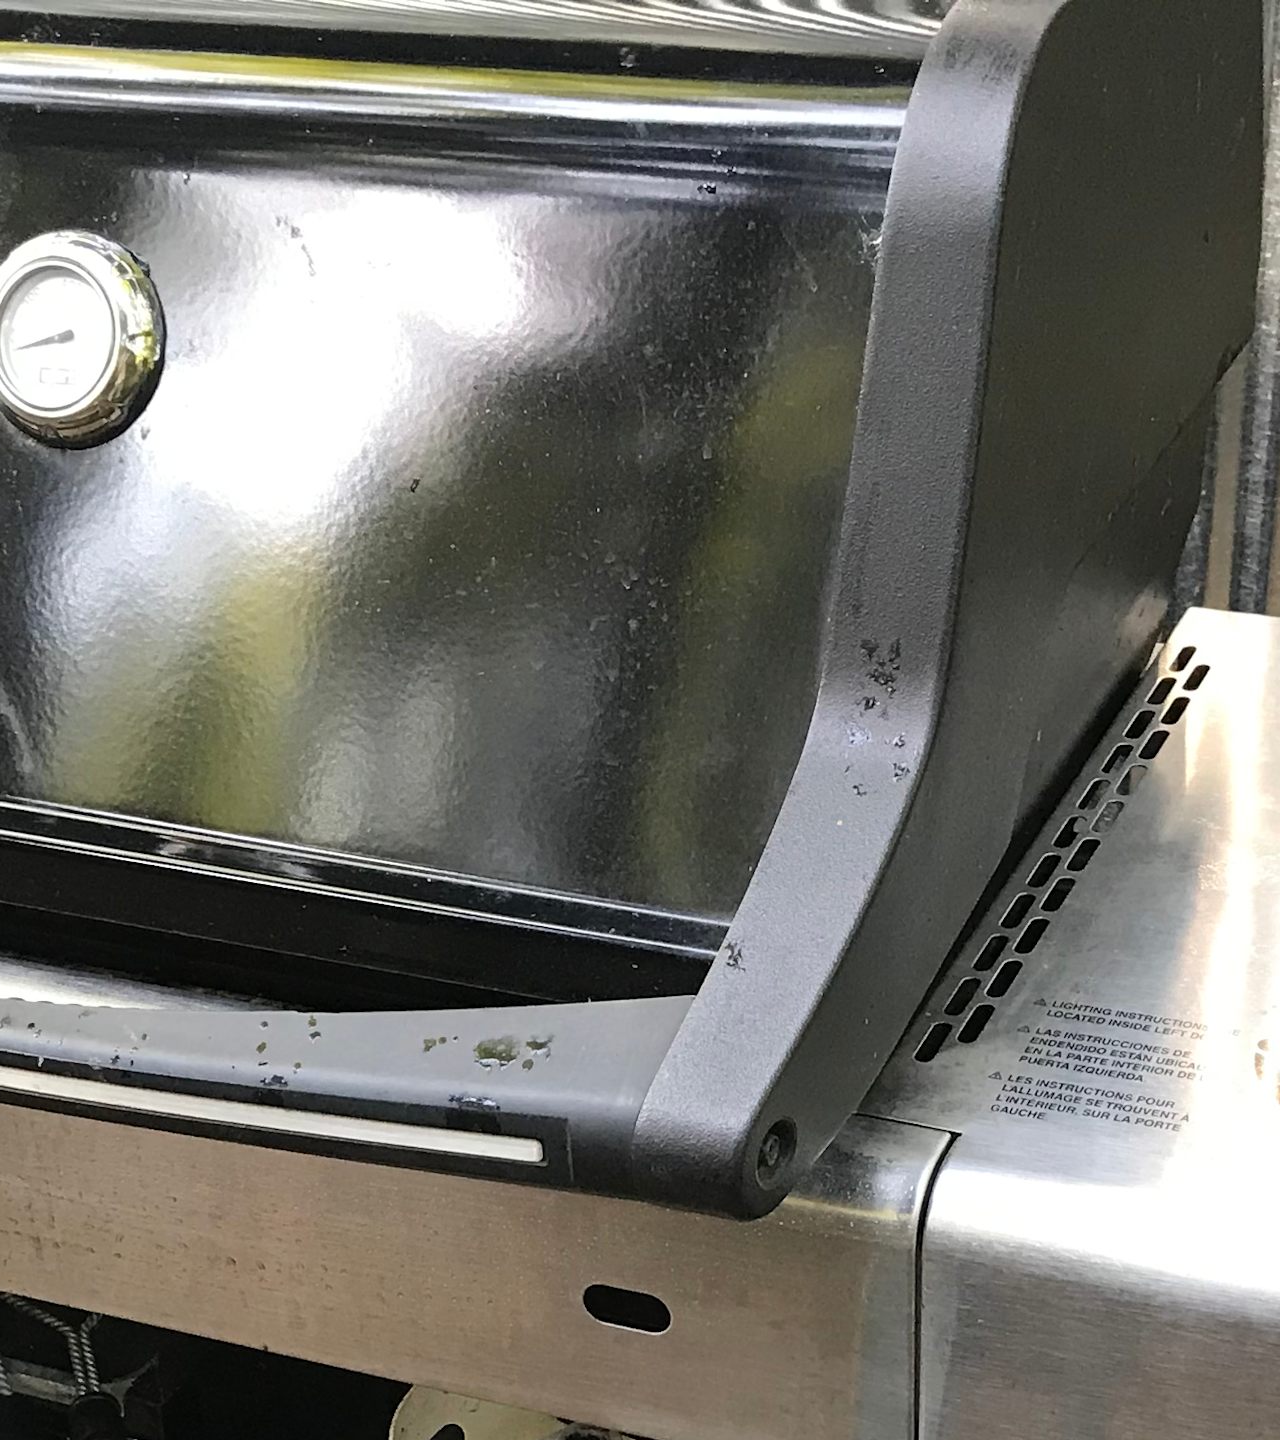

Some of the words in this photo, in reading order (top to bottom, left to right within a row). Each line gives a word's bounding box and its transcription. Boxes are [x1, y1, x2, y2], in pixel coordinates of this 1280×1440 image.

[1052, 1000, 1111, 1016] LIGHTING
[1046, 1009, 1105, 1026] LOCATED
[1108, 1019, 1151, 1033] INSIDE
[1154, 1026, 1188, 1039] LEFT
[1029, 1036, 1106, 1055] ENDENDIDO
[1035, 1027, 1061, 1038] LAS
[1063, 1032, 1170, 1056] INSTRUCCIONES
[1172, 1049, 1193, 1059] DE
[1019, 1055, 1070, 1071] PUERTA
[1073, 1064, 1144, 1083] IZQUIERDA
[1024, 1045, 1042, 1055] EN
[1046, 1049, 1063, 1059] LA
[1066, 1052, 1109, 1067] PARTE
[1111, 1060, 1174, 1077] INTERIOR
[1176, 1070, 1196, 1081] DE
[1007, 1074, 1033, 1085] LES
[1035, 1079, 1138, 1102] INSTRUCTIONS
[1136, 1095, 1176, 1109] POUR
[990, 1104, 1047, 1121] GAUCHE
[1082, 1108, 1111, 1121] SUR
[1113, 1114, 1131, 1124] LA
[1134, 1118, 1182, 1133] PORTE
[1085, 1097, 1102, 1108] SE
[1106, 1102, 1180, 1120] TROUVENT
